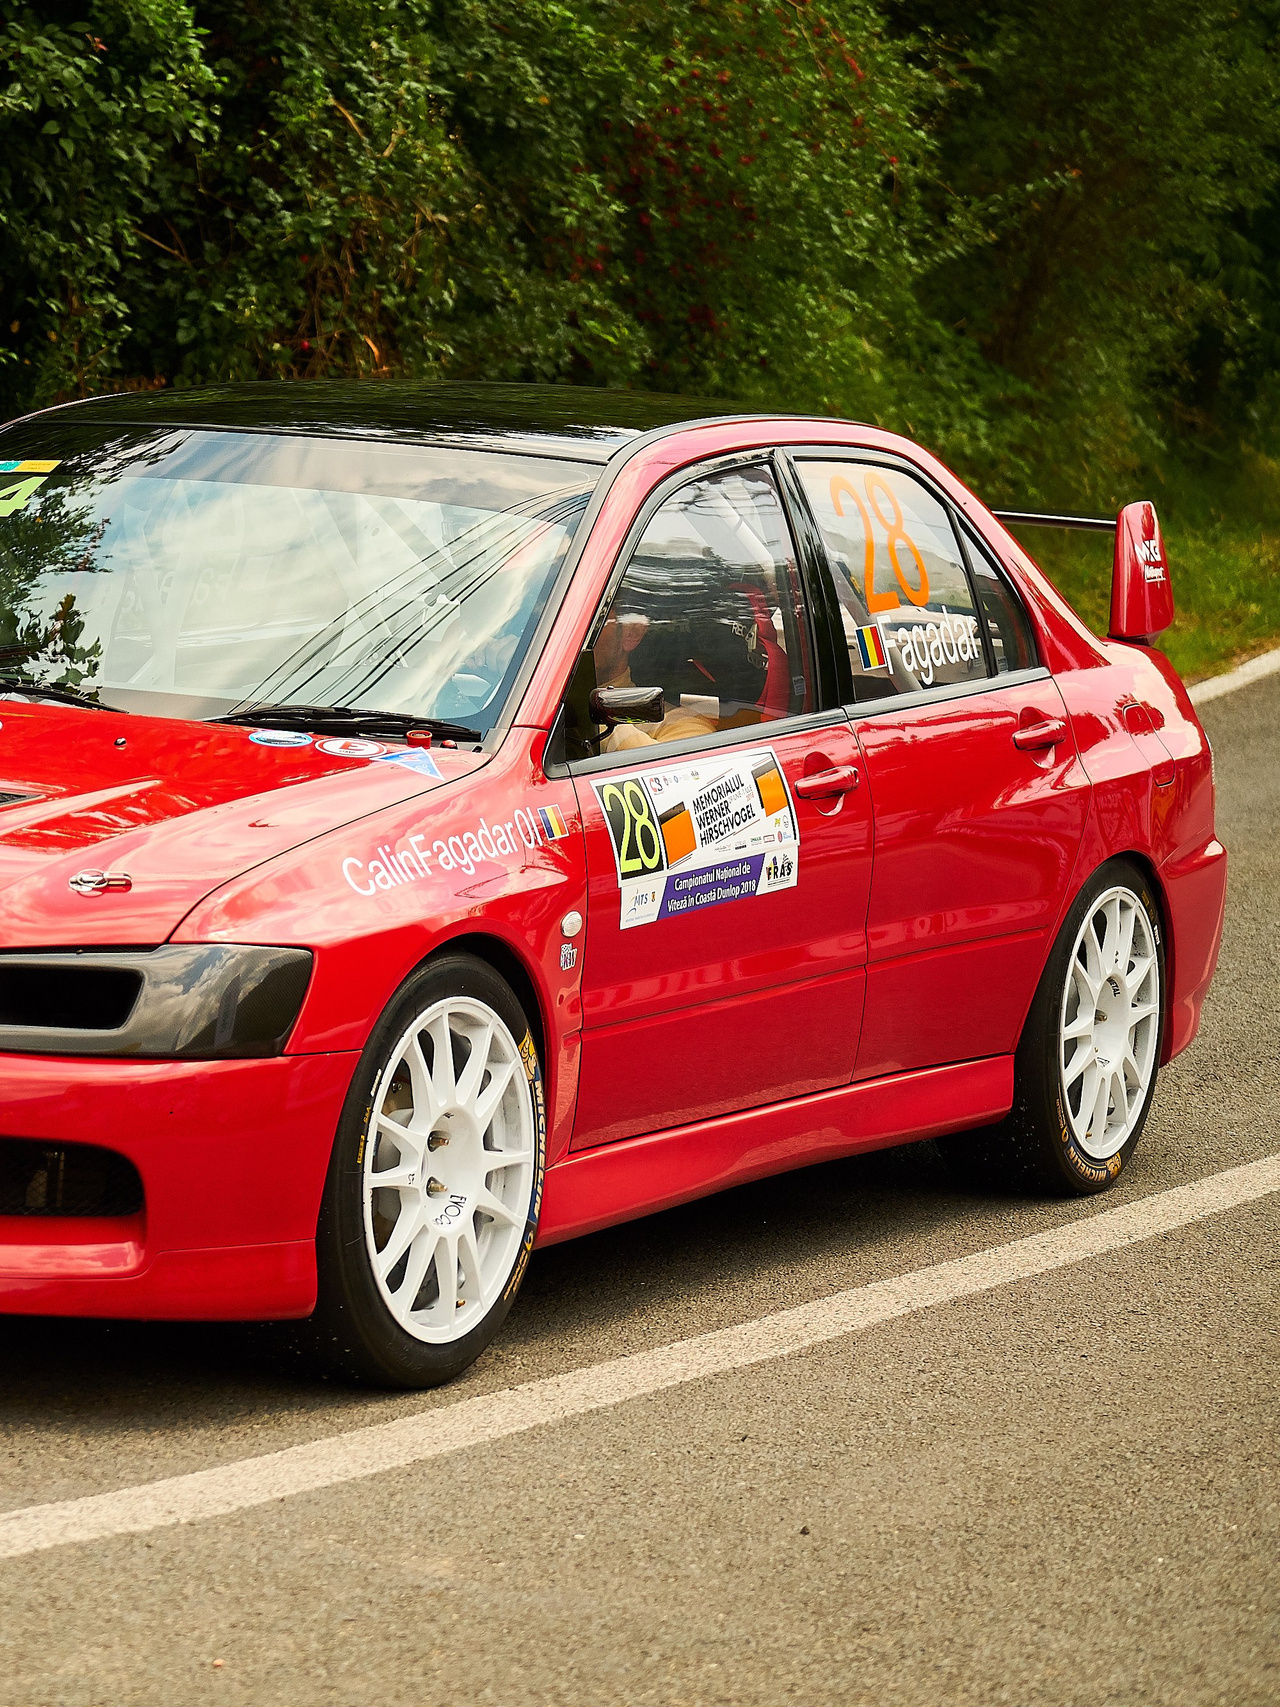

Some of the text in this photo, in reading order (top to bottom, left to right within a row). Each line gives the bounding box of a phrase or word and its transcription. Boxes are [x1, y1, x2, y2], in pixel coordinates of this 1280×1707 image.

[829, 472, 931, 614] 28
[876, 605, 981, 685] Fagadar
[692, 773, 745, 815] MEMORIALUL
[696, 799, 732, 831] WERNER
[602, 781, 660, 873] 28
[699, 803, 756, 848] HIRSCHVOGEL
[667, 896, 687, 913] Viteză
[695, 888, 717, 905] Coastă
[717, 883, 741, 899] Dunlop
[740, 879, 757, 895] 2018
[674, 868, 715, 891] Campionatul
[742, 861, 751, 875] de
[534, 1079, 547, 1219] MICHELIN
[1066, 1145, 1108, 1182] MICHELIN
